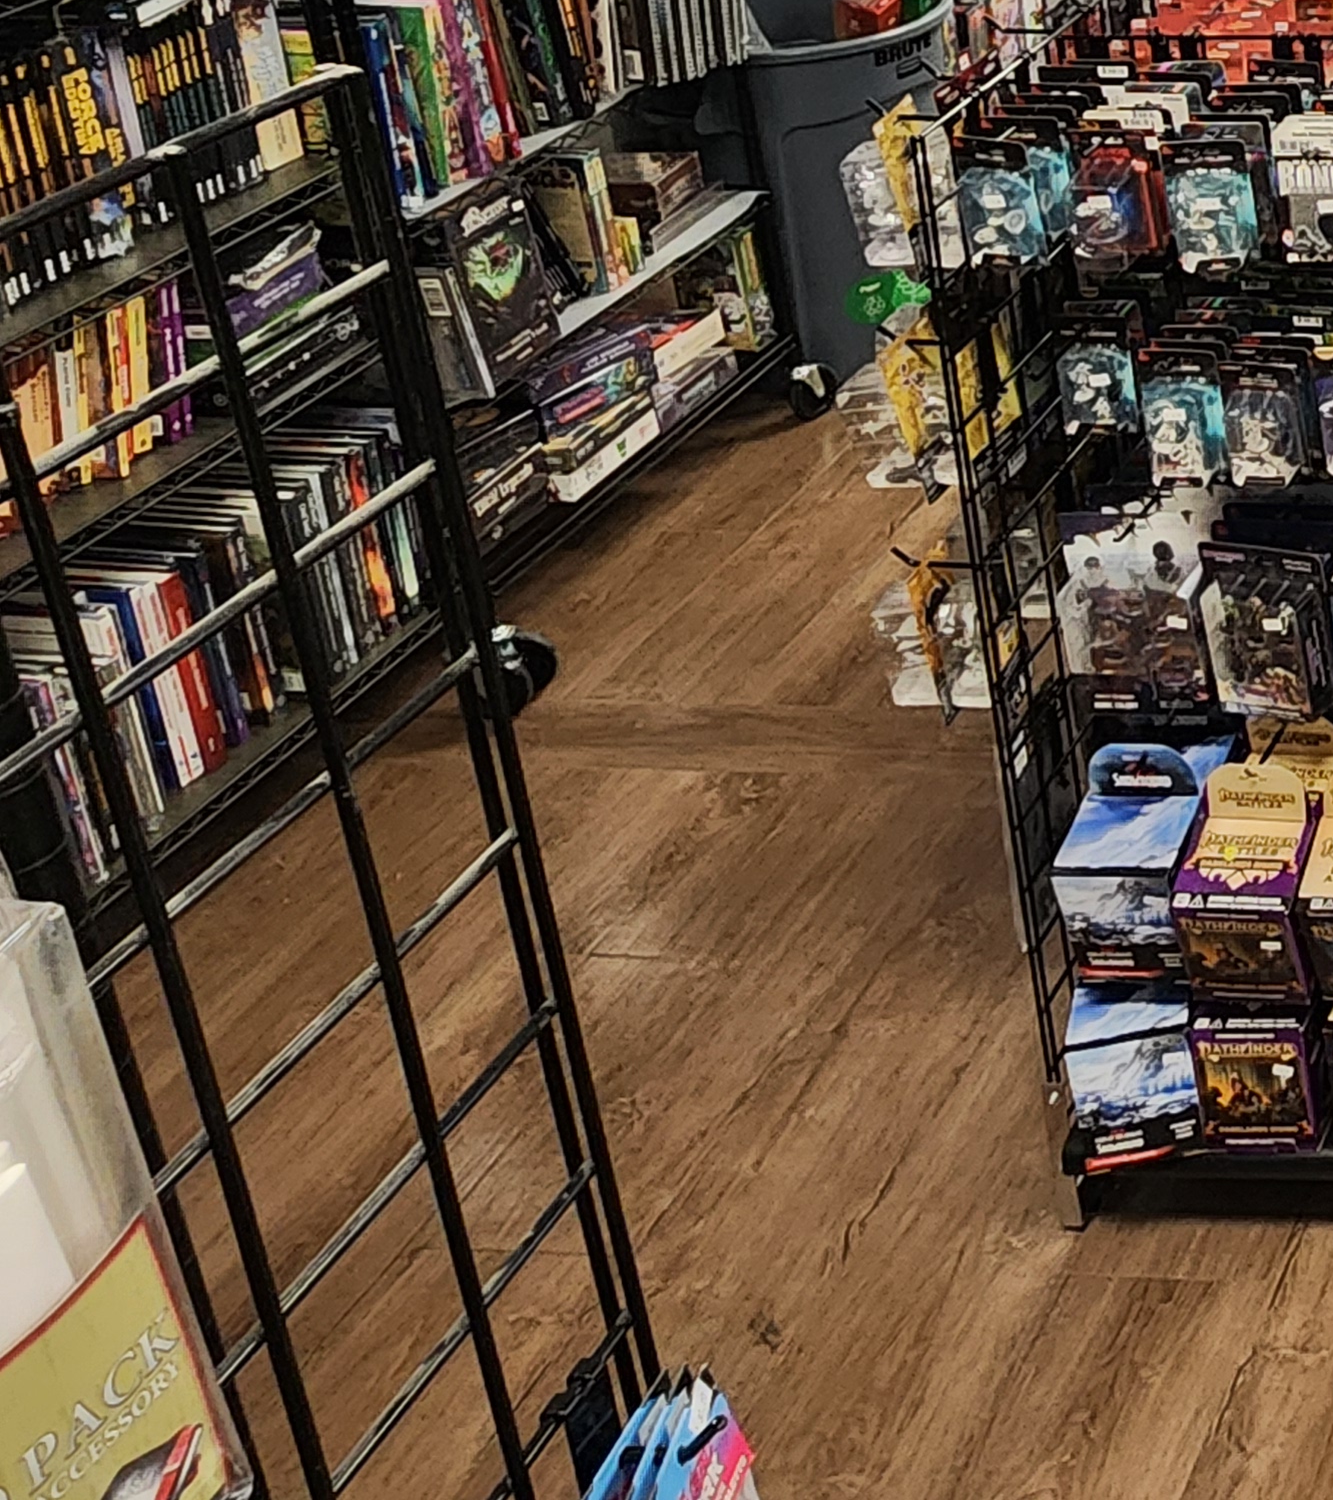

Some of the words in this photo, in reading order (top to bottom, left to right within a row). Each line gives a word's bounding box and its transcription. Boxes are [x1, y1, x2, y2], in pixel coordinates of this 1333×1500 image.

[873, 33, 933, 67] BRUTE
[1218, 787, 1296, 804] PATHFINDER
[1200, 831, 1299, 850] PATHFINDER
[1218, 847, 1280, 857] BTTLES
[1196, 1041, 1298, 1062] PATHFINDER
[21, 1306, 180, 1497] PACK
[36, 1360, 179, 1500] CCESSORY
